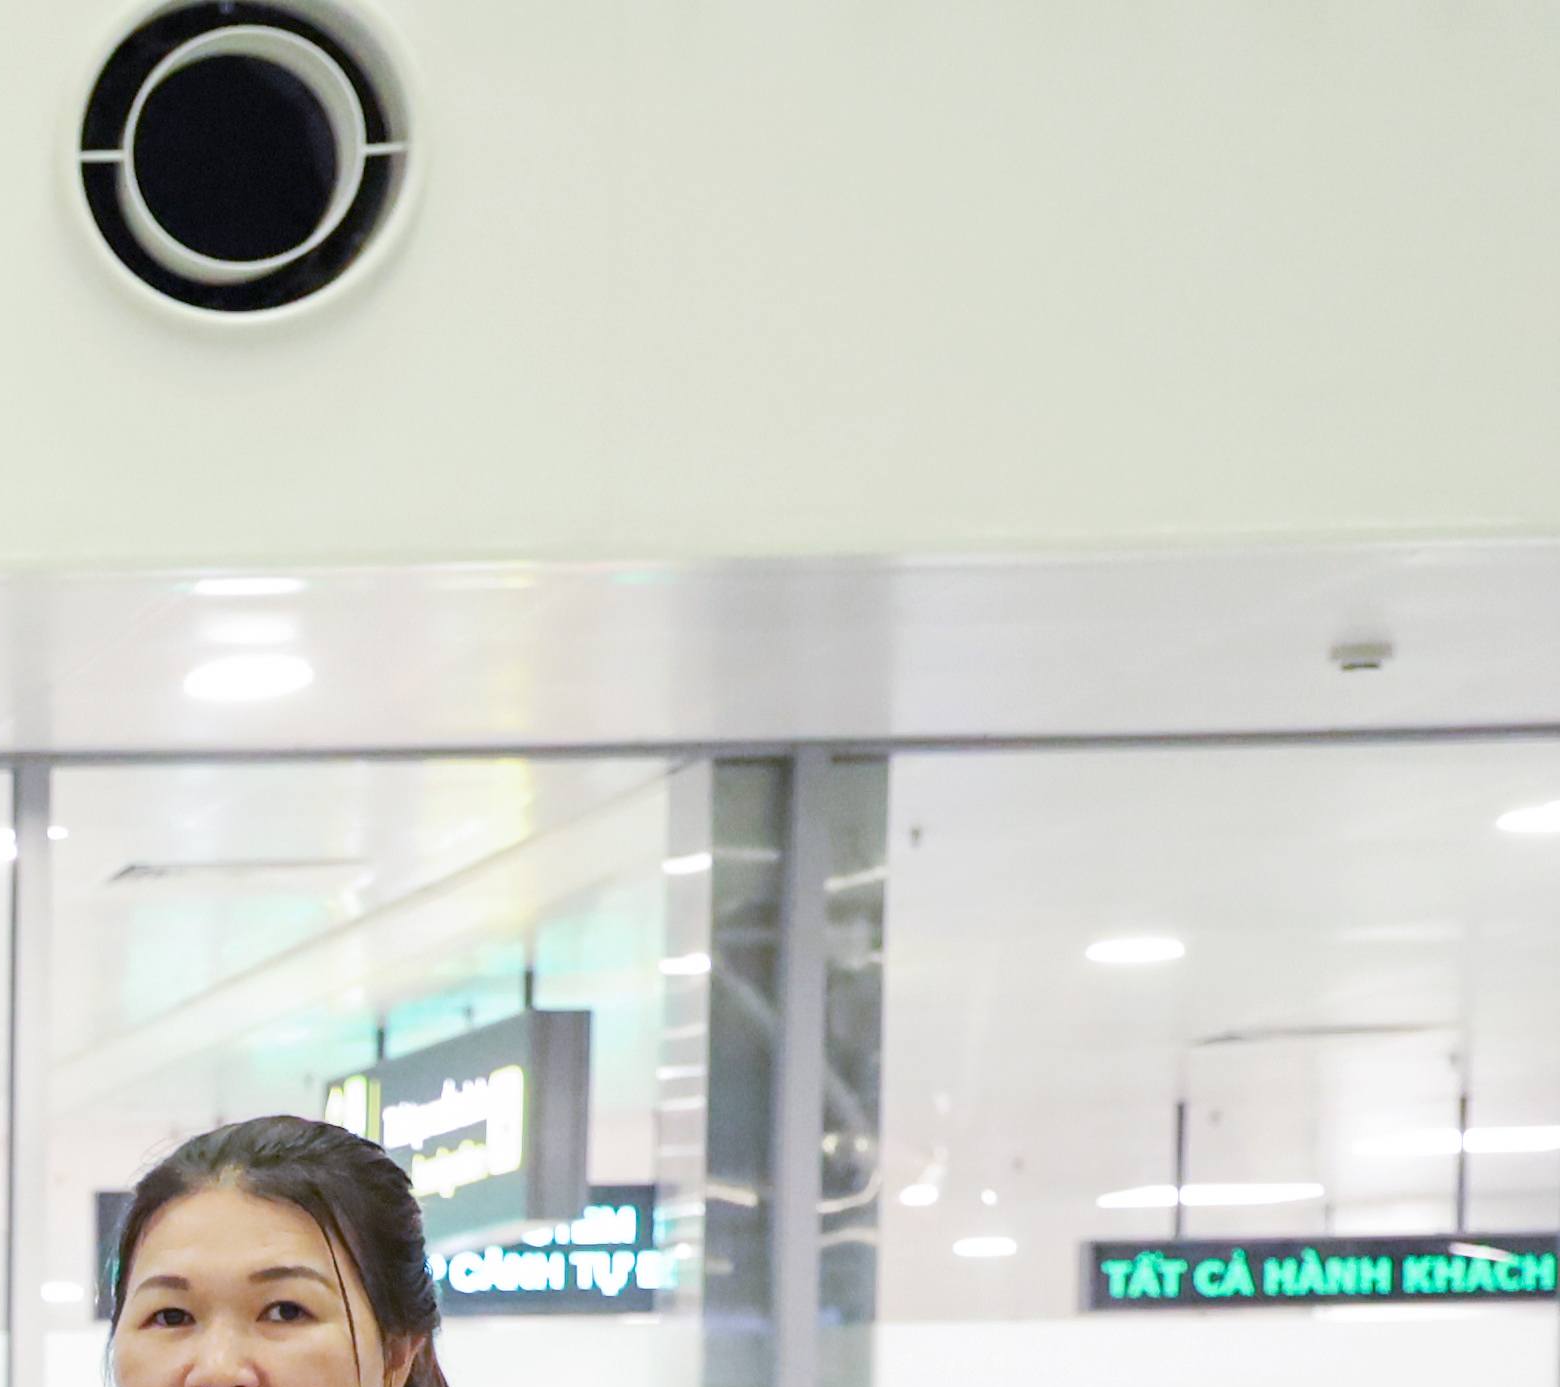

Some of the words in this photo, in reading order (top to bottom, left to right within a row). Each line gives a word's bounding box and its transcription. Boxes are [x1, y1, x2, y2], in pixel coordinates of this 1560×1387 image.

[1100, 1249, 1188, 1298] TẤT
[1193, 1247, 1256, 1297] CẢ
[1263, 1246, 1394, 1296] HÀNH
